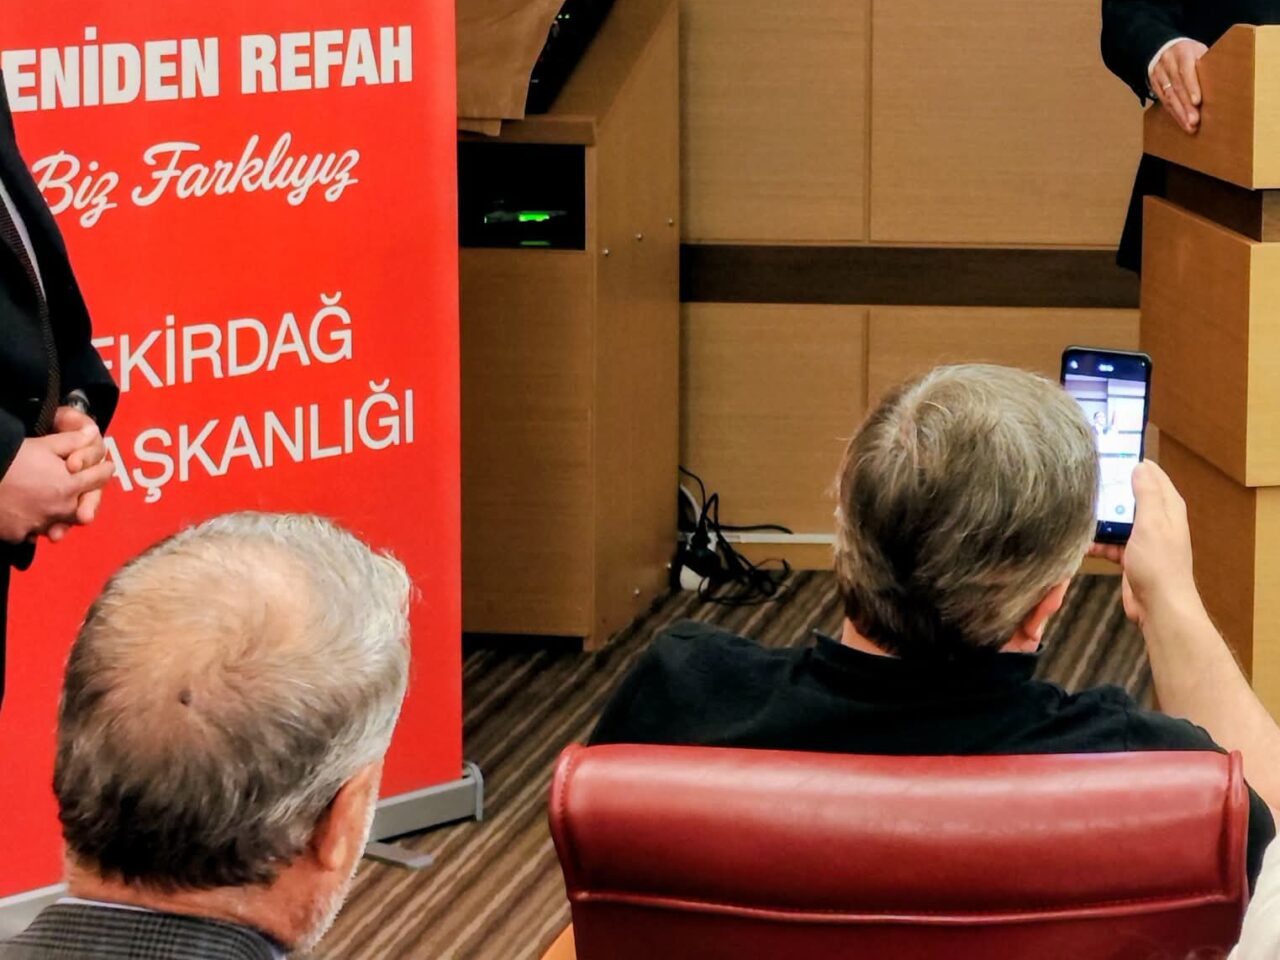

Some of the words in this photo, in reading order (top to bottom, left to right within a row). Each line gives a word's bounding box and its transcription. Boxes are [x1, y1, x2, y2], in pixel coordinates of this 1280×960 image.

[0, 25, 220, 114] ENİDEN
[240, 25, 413, 96] REFAH
[32, 150, 119, 229] Biz
[131, 131, 360, 207] Farklıyız
[91, 291, 353, 393] KİRDAĞ
[103, 378, 414, 503] AŞKANLIĞI
